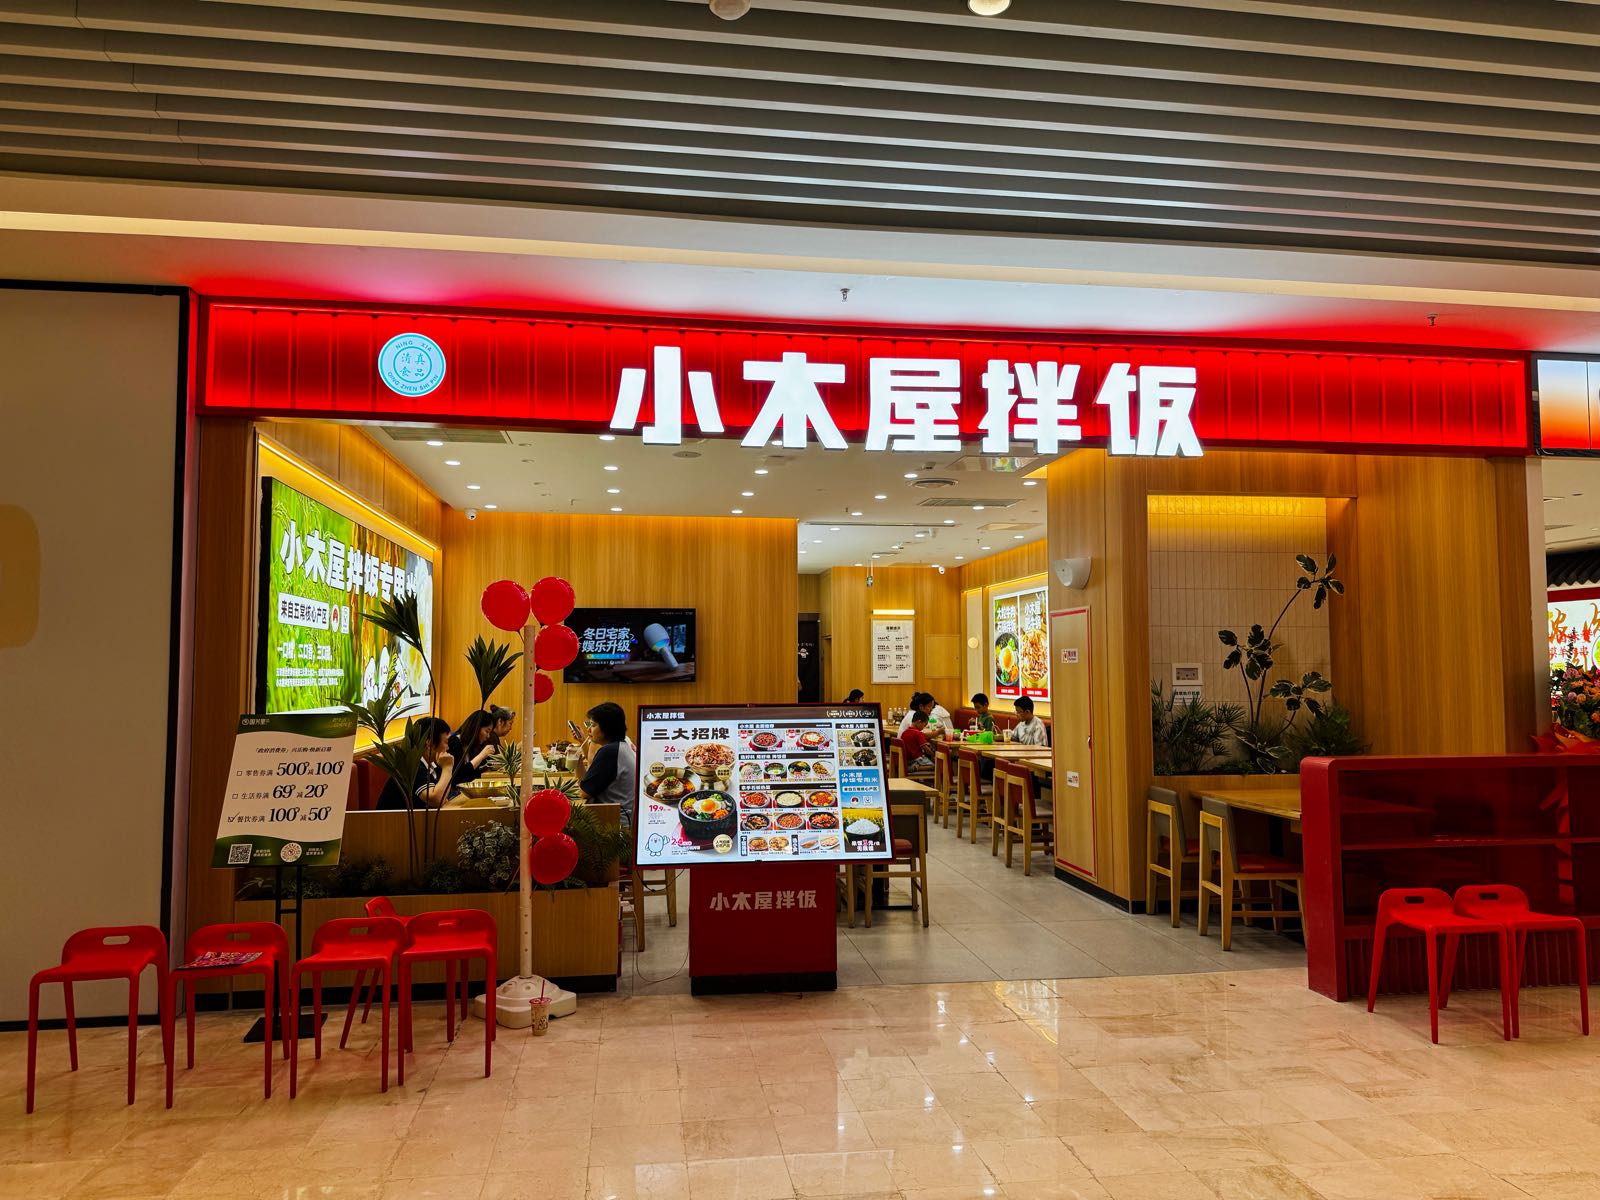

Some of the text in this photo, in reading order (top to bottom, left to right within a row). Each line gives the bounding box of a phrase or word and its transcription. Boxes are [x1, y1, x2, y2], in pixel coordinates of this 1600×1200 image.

[395, 340, 432, 352] NING XIA
[400, 384, 418, 392] ZHEN
[429, 374, 439, 385] PIN
[608, 346, 1204, 457] 小木屋拌饭
[583, 627, 631, 640] 冬日宅家
[581, 640, 632, 654] 娱乐升级
[650, 727, 730, 741] 三大招牌
[664, 745, 676, 753] 26
[648, 804, 664, 812] 19.9
[709, 889, 818, 911] 小木屋拌饭
